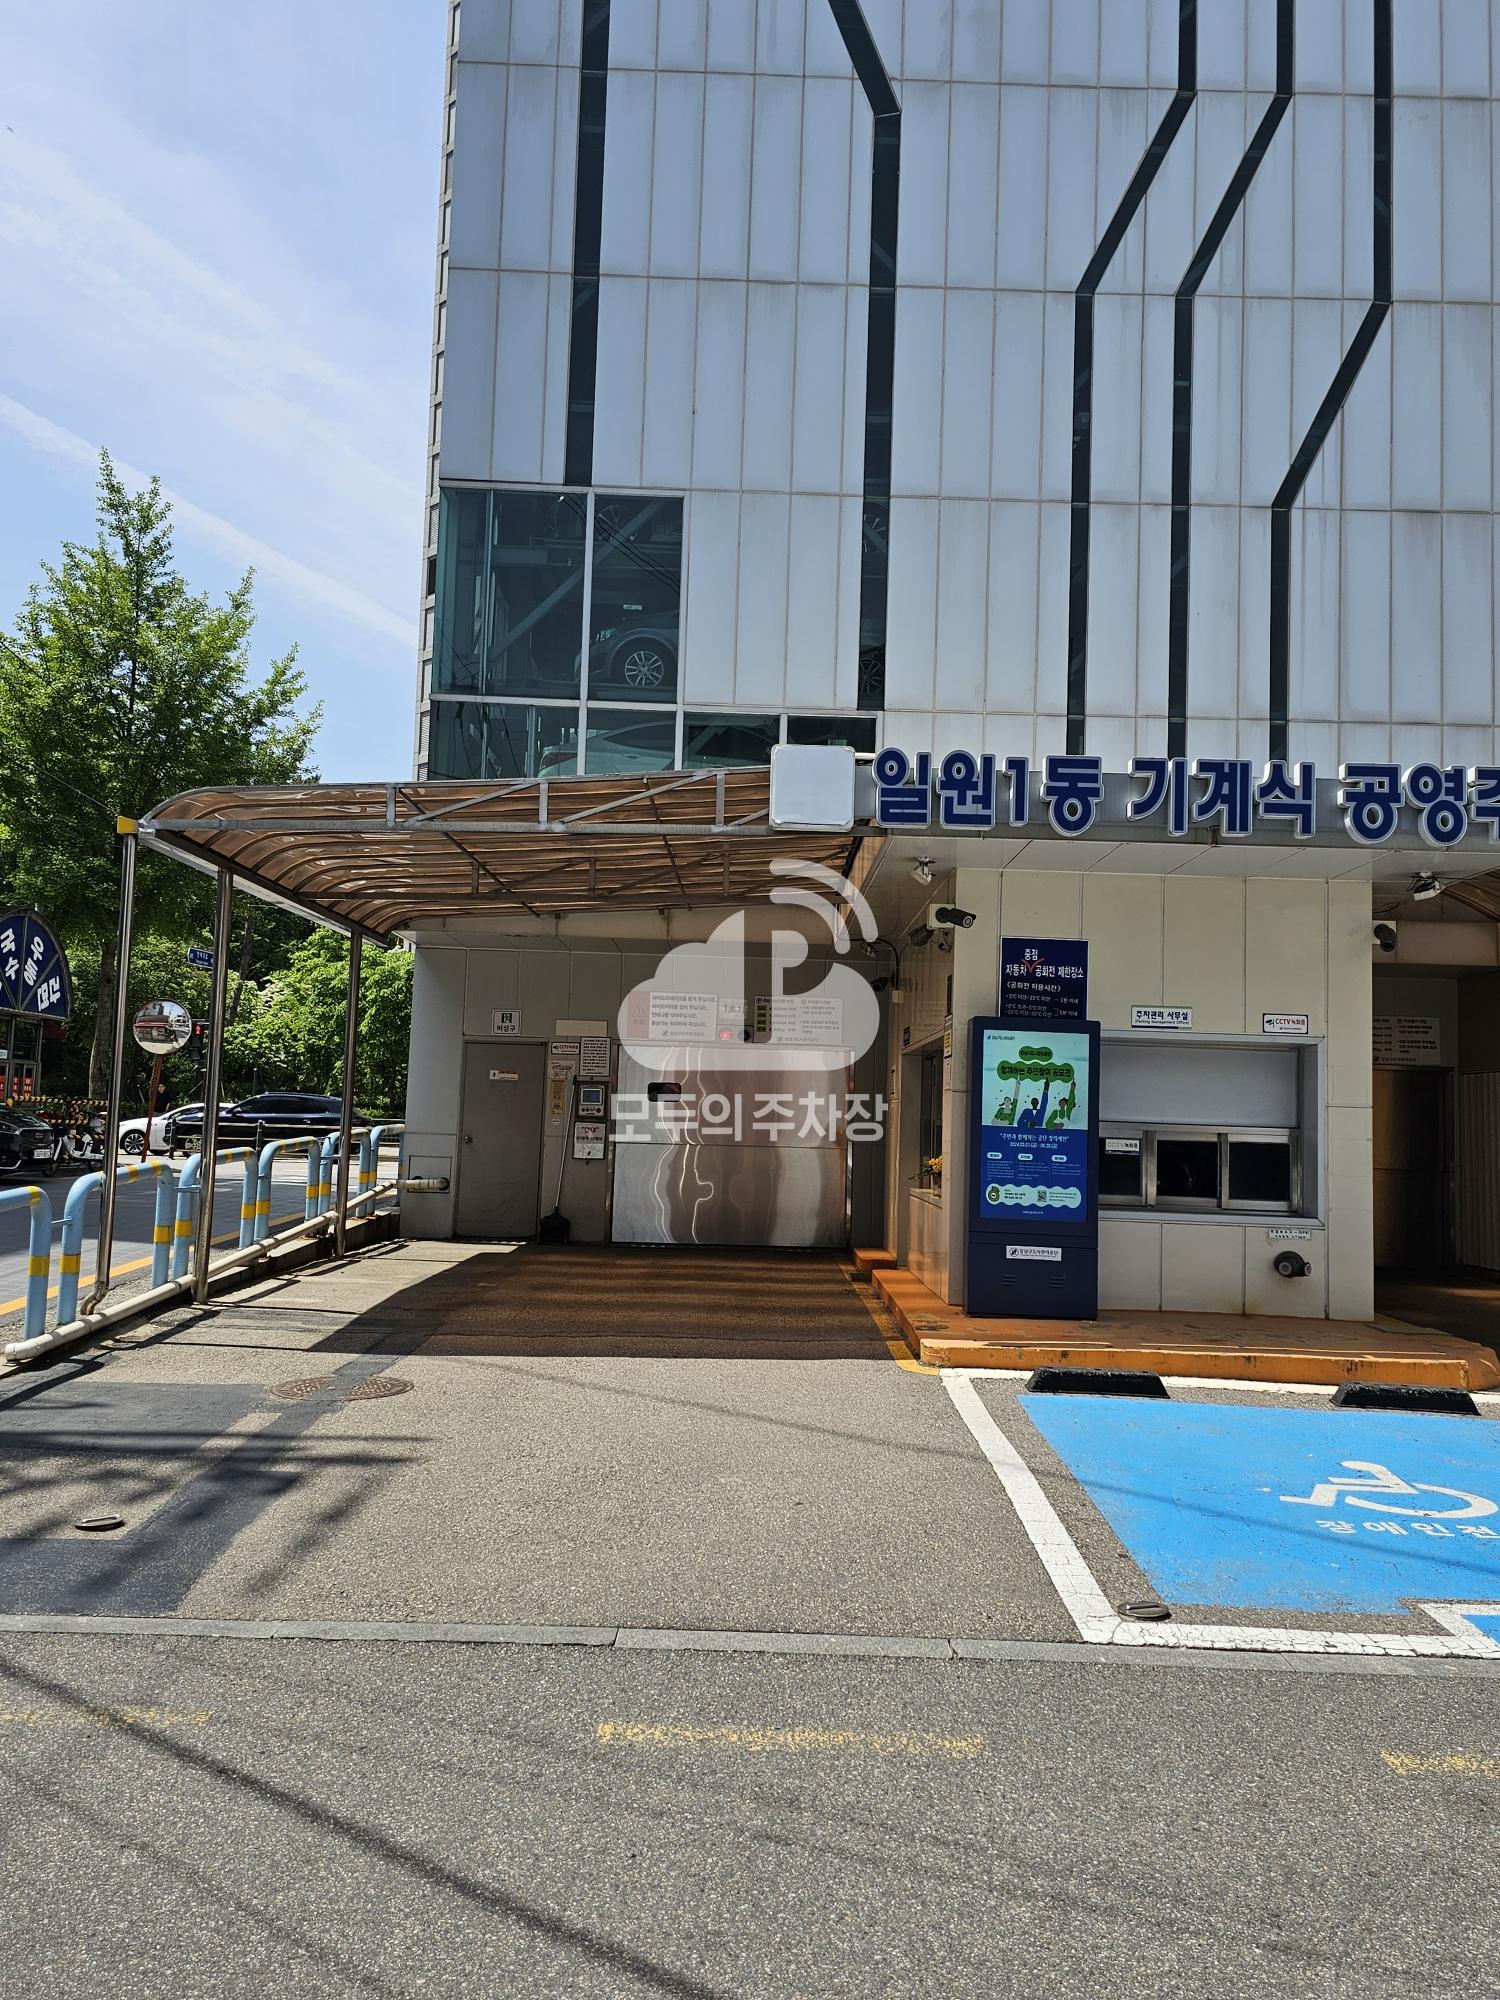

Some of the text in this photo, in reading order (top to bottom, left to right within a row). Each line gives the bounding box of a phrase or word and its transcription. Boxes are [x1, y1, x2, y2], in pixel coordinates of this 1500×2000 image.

[872, 747, 1104, 837] 일원1동
[1127, 756, 1316, 838] 기계식
[0, 928, 20, 981] 국수
[23, 936, 45, 987] 우동
[1024, 949, 1038, 961] 중점
[1005, 964, 1084, 978] 자동차 공회전 제한장소
[37, 975, 61, 1012] 라면
[1136, 1010, 1188, 1021] 주차관리 사무실
[496, 1025, 516, 1033] 비상구
